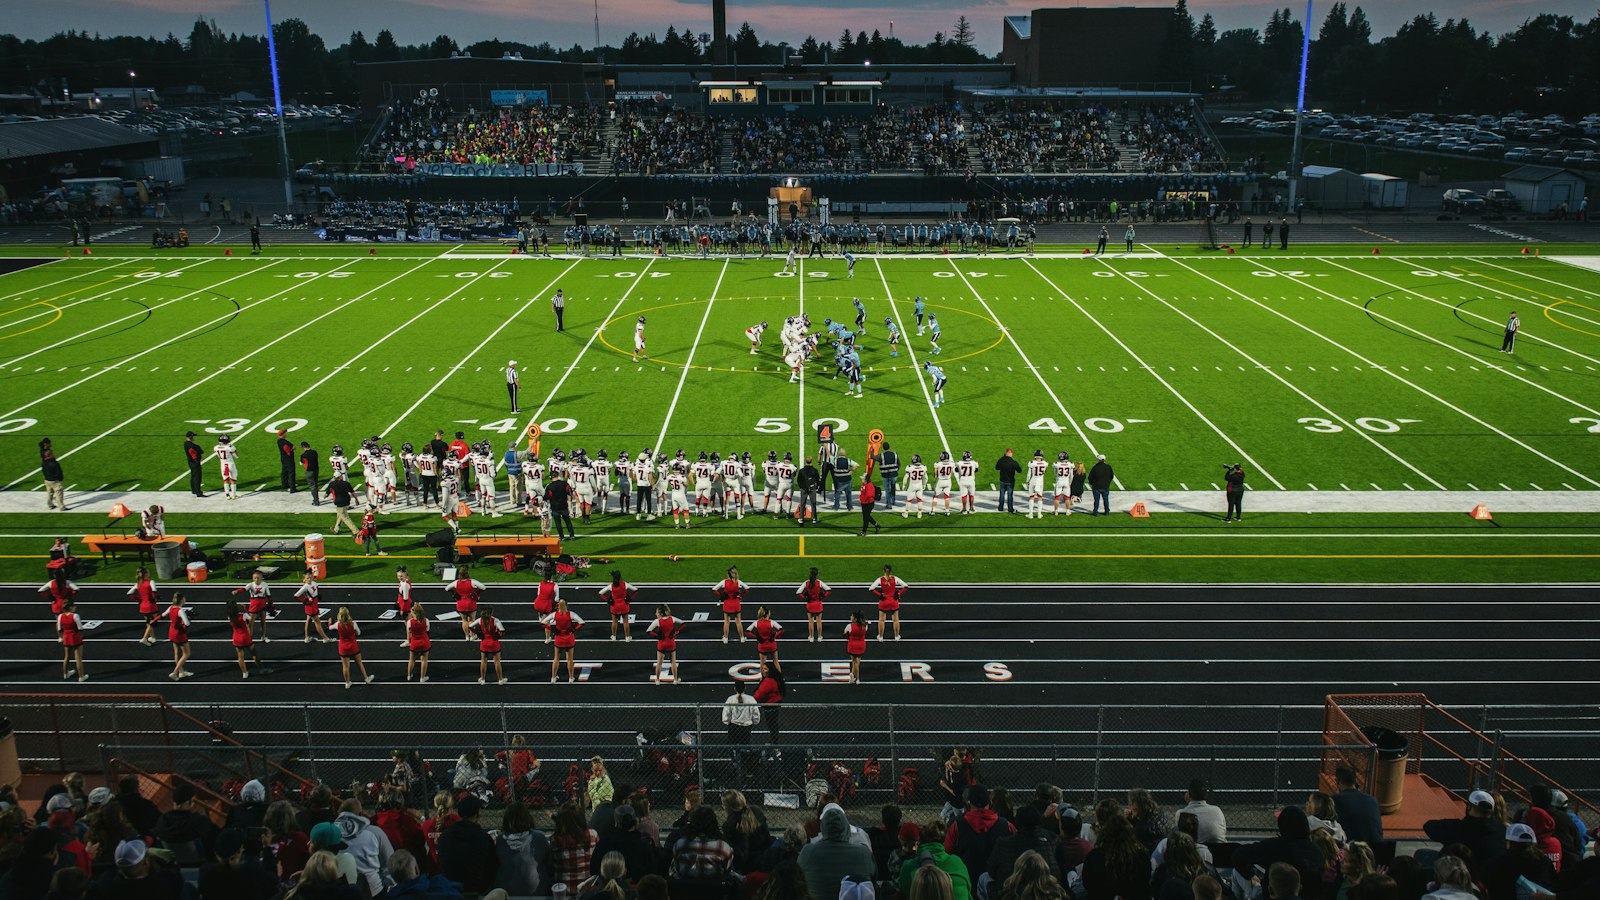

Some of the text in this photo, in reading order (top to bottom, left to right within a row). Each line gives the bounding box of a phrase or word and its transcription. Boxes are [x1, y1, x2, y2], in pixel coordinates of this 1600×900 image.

[205, 418, 308, 434] 30
[479, 417, 578, 434] 40
[1027, 416, 1124, 434] 40
[1297, 416, 1401, 434] 30
[820, 425, 831, 440] 4
[476, 463, 488, 475] 50
[527, 469, 540, 479] 44
[596, 466, 606, 476] 19
[696, 468, 708, 478] 74
[724, 464, 735, 476] 10
[940, 466, 952, 476] 40
[961, 466, 973, 477] 71
[1034, 466, 1045, 476] 15
[1058, 467, 1070, 477] 33
[573, 471, 585, 483] 77
[911, 470, 924, 481] 35
